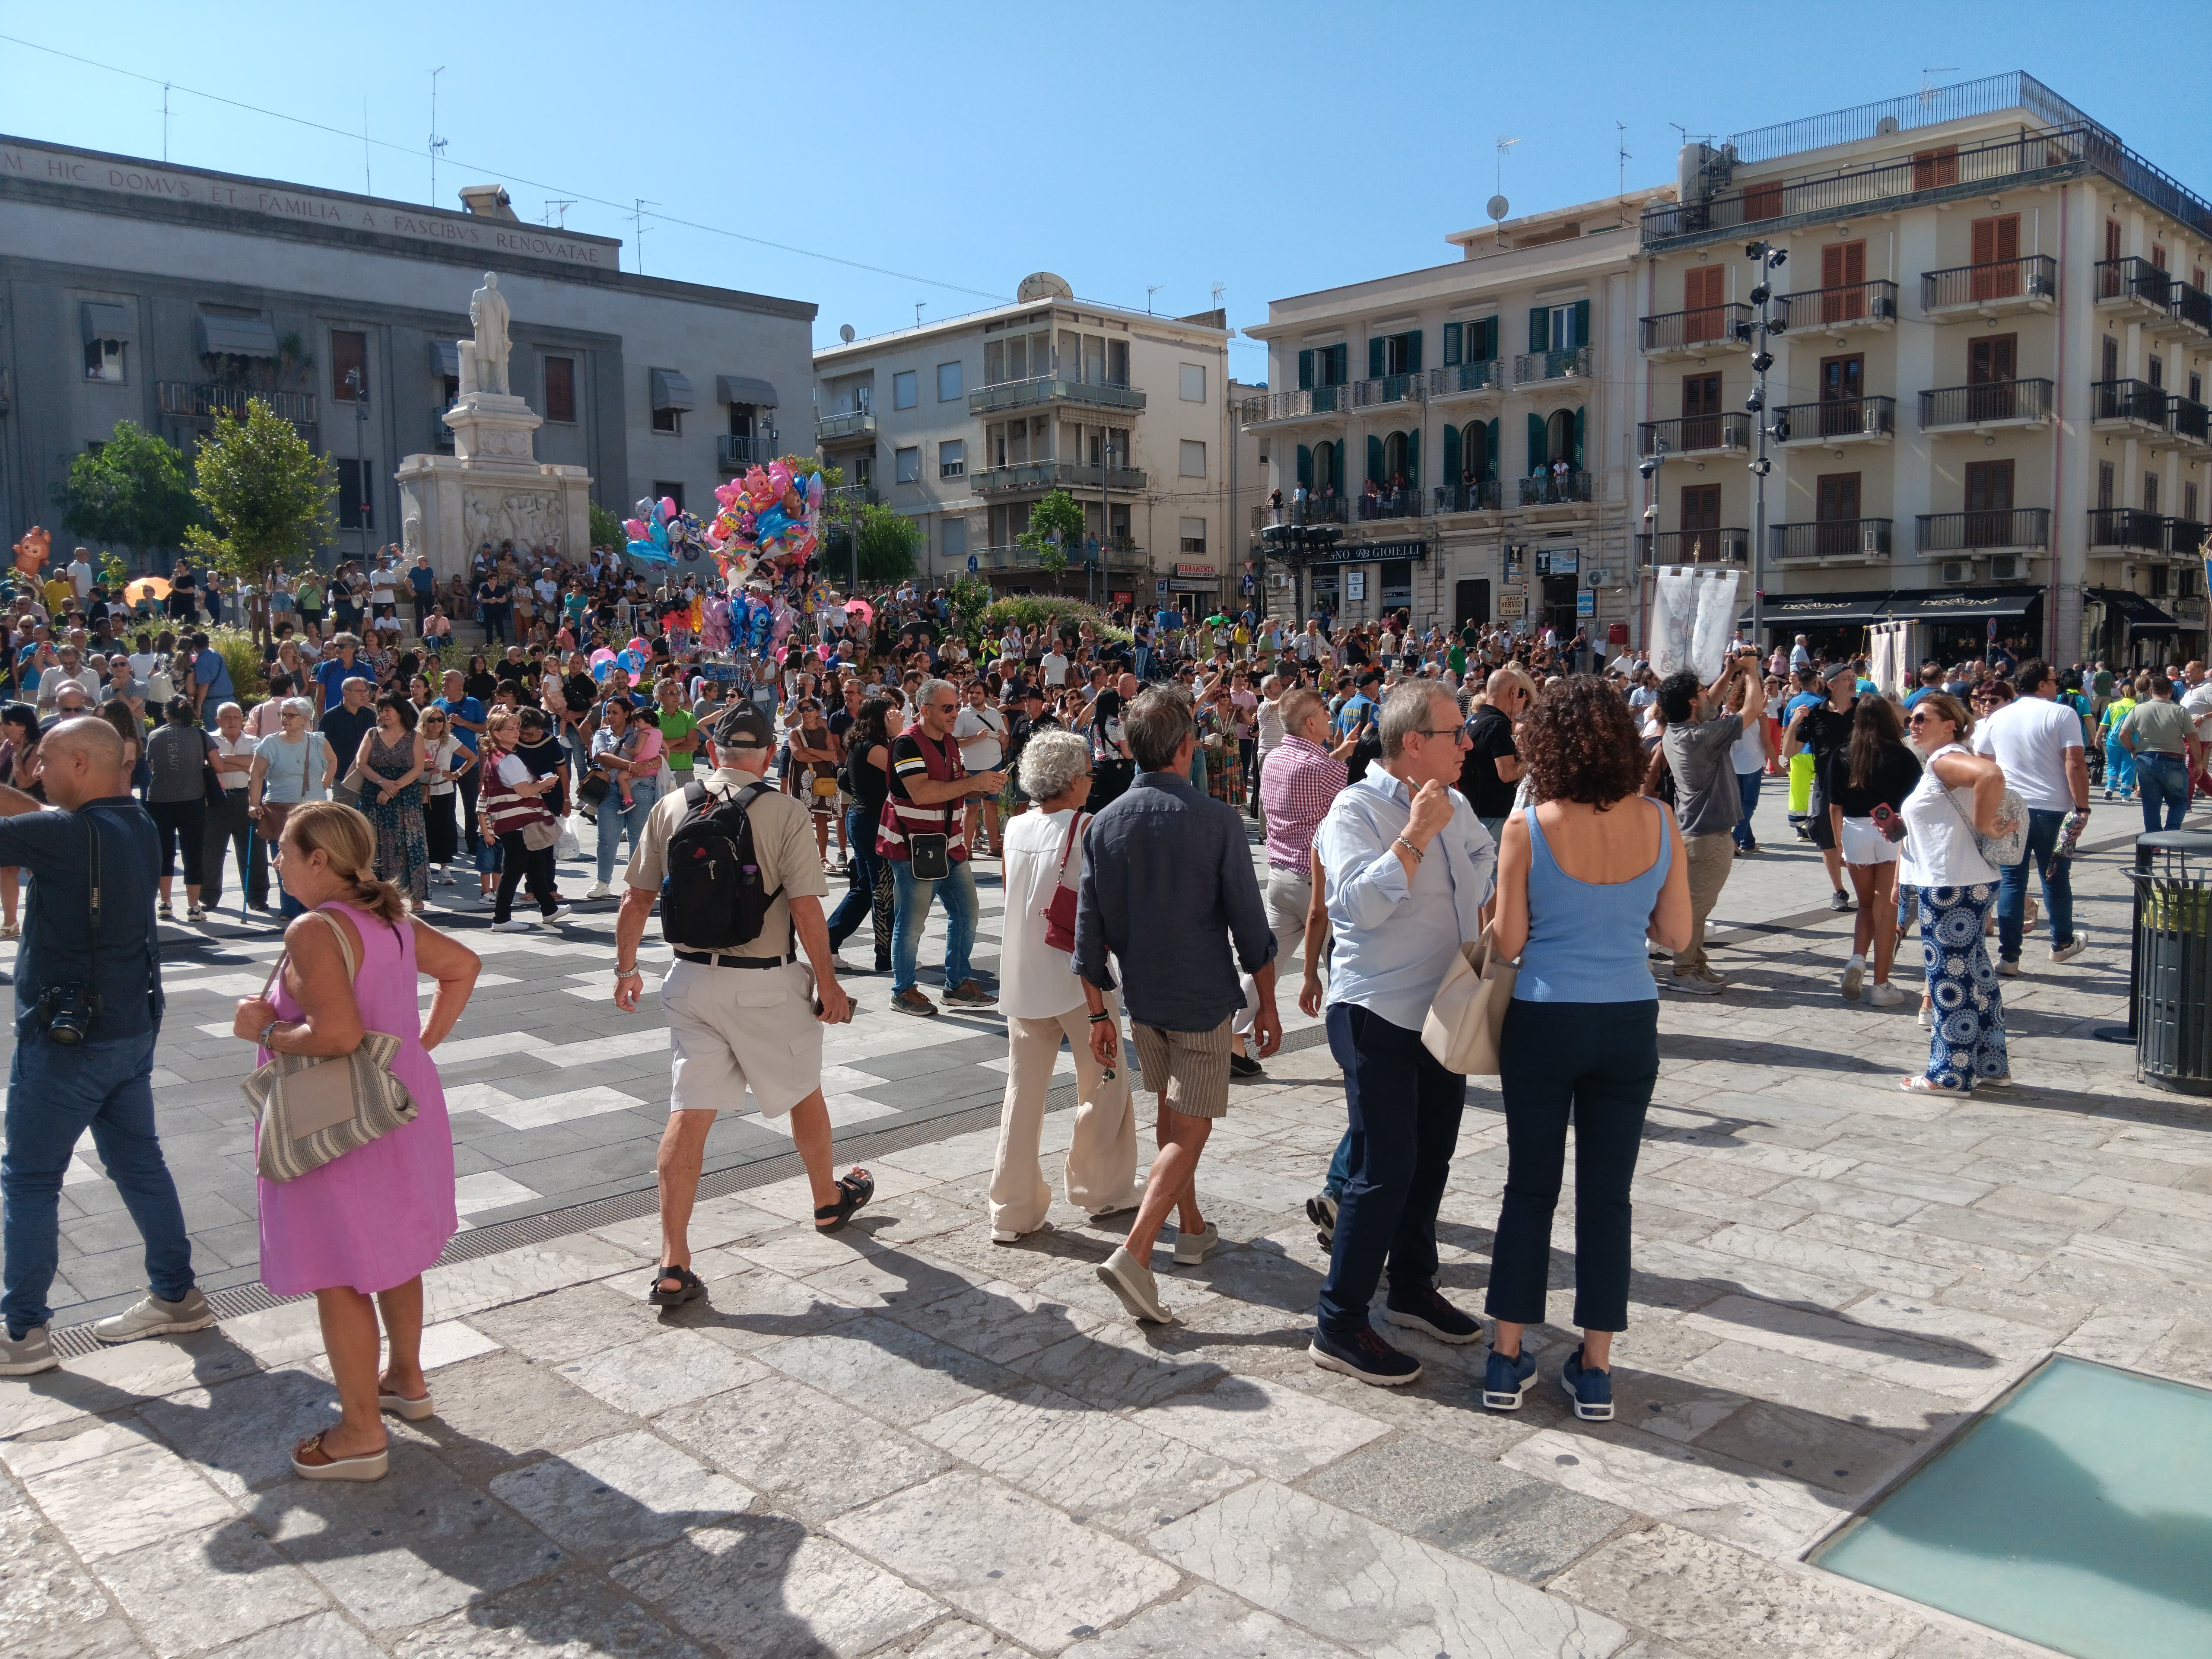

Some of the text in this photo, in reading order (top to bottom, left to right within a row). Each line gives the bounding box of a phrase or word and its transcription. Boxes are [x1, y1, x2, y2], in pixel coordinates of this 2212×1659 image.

[48, 159, 86, 181] HIC
[109, 170, 190, 197] DOMVS
[212, 186, 237, 204] ET
[258, 193, 341, 221] FAMILIA
[362, 212, 375, 226] A
[394, 216, 479, 243] FASCIBVS
[497, 232, 598, 263] RENOVATAE
[1373, 545, 1419, 558] GIOIELLI
[1178, 564, 1214, 573] FERRAMENTA
[1780, 602, 1852, 610] DENAVINO
[1919, 597, 1998, 606] DENAVINO
[167, 742, 180, 771] READY
